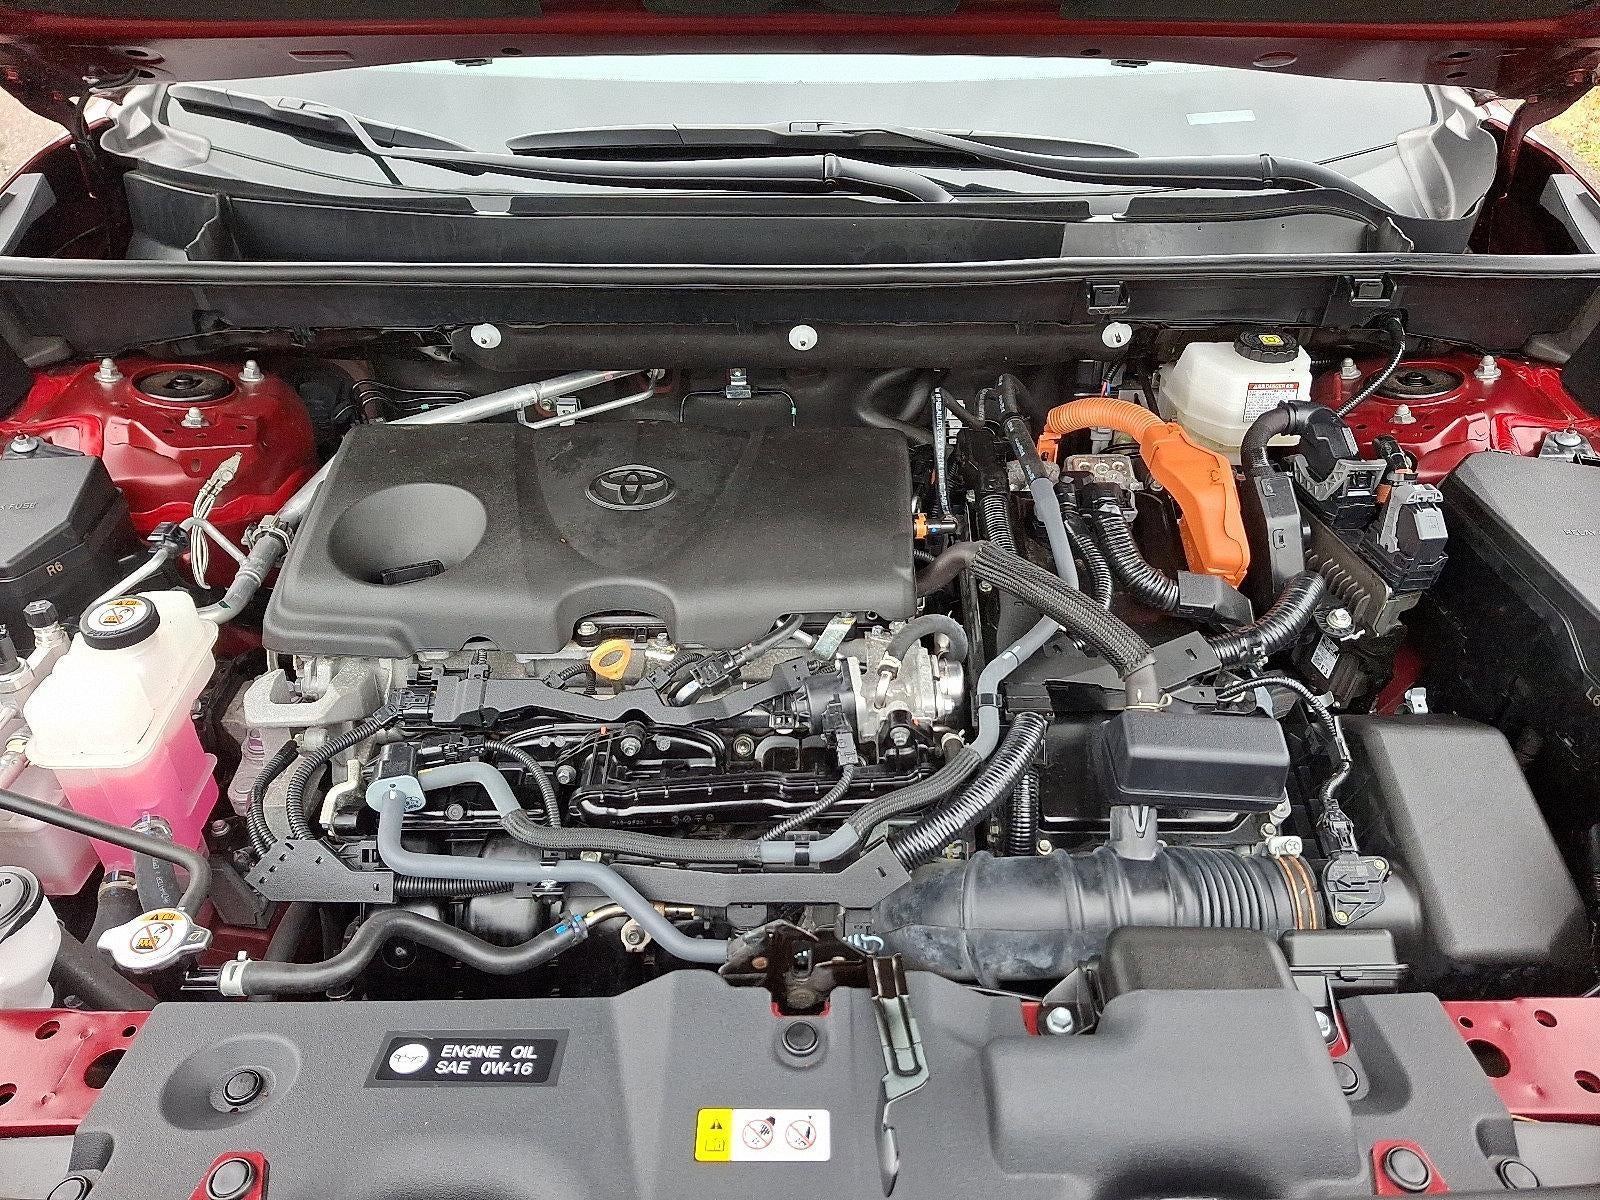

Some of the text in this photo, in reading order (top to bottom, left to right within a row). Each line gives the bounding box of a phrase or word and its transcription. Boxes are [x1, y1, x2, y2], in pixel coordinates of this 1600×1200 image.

[46, 561, 64, 577] R6
[440, 1044, 538, 1059] ENGINE OIL
[434, 1061, 534, 1076] SAE 0W-16
